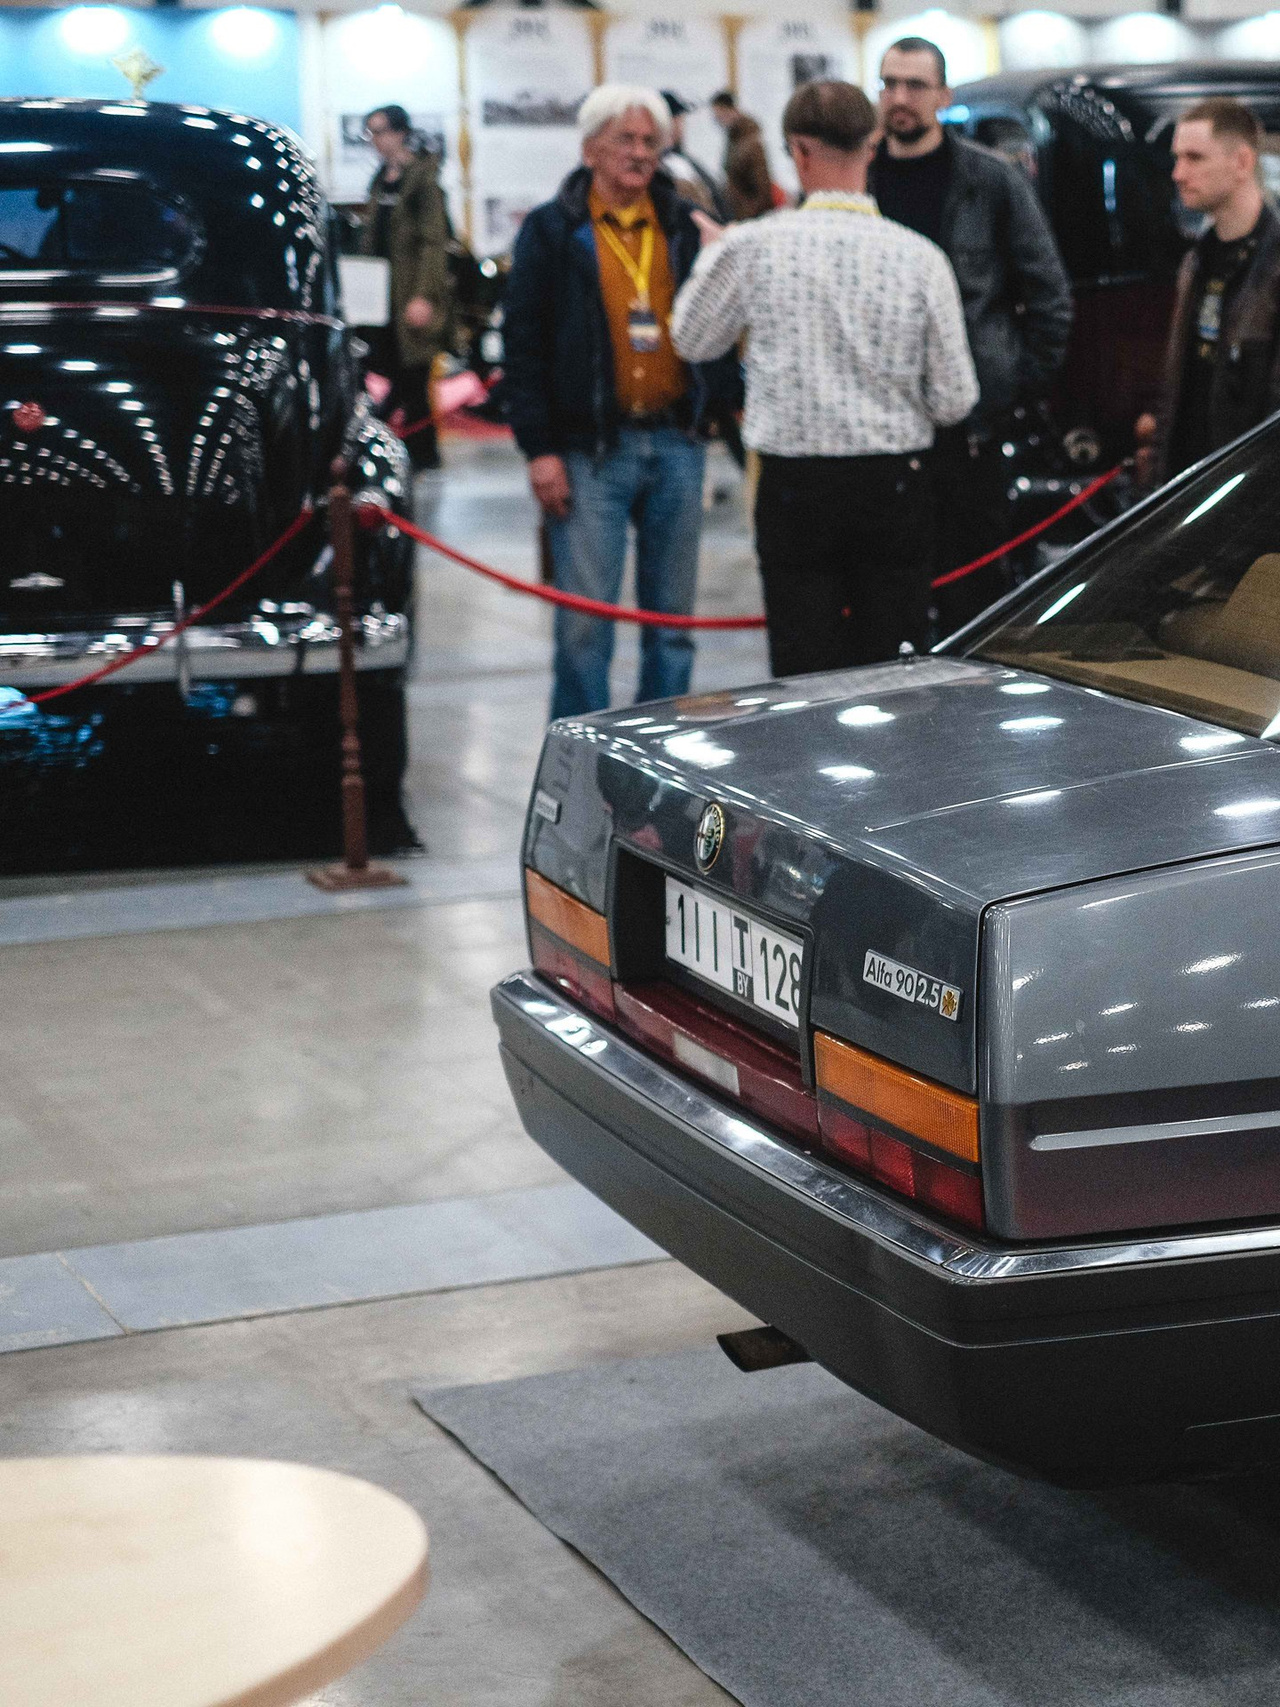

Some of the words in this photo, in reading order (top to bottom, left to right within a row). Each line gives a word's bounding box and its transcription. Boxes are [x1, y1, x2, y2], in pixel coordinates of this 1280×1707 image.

[737, 971, 749, 998] BY
[760, 937, 802, 1017] 128
[865, 957, 893, 989] Alfa
[896, 969, 915, 997] 90
